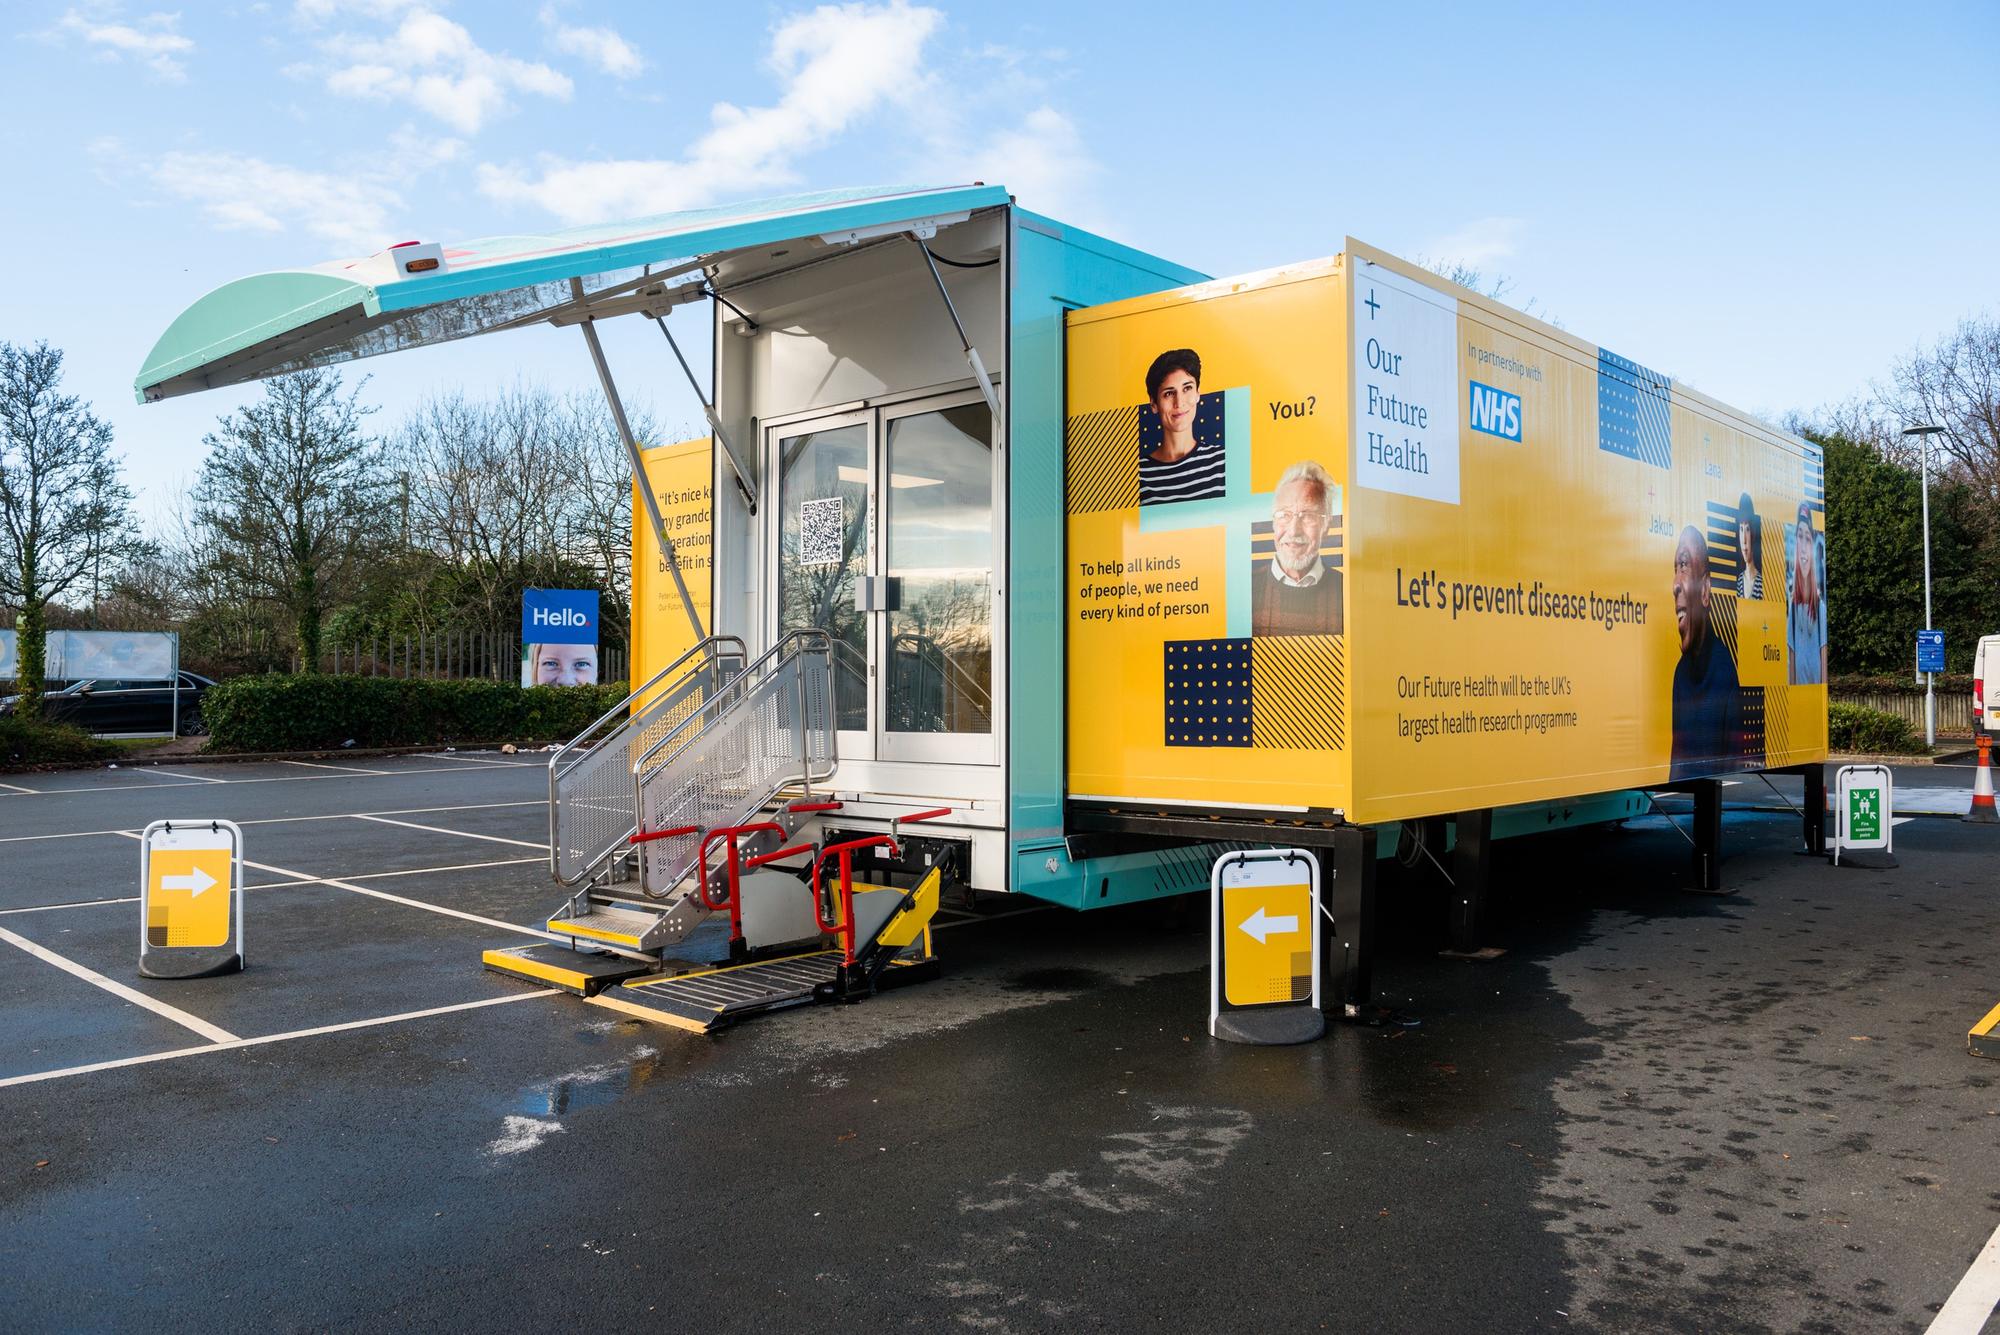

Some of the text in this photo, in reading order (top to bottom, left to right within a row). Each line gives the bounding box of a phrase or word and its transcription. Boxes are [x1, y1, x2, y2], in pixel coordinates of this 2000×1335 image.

[1366, 337, 1402, 377] Our
[1468, 341, 1542, 382] In partnership with
[1270, 396, 1317, 421] You?
[1367, 384, 1428, 430] Future
[1471, 386, 1520, 437] NHS
[1368, 432, 1429, 475] Health
[681, 488, 702, 503] nice
[1648, 513, 1674, 537] Jakub
[659, 555, 693, 573] beefit
[695, 555, 705, 569] in
[1080, 555, 1181, 577] To help all kinds
[1080, 577, 1199, 600] of people, we need
[1396, 567, 1648, 631] Let's prevent disease together
[1080, 602, 1209, 622] every kind of person
[1763, 644, 1780, 661] Olivia
[1397, 675, 1572, 698] Our Future Health will be the UK's
[1398, 709, 1578, 743] largest health research programme
